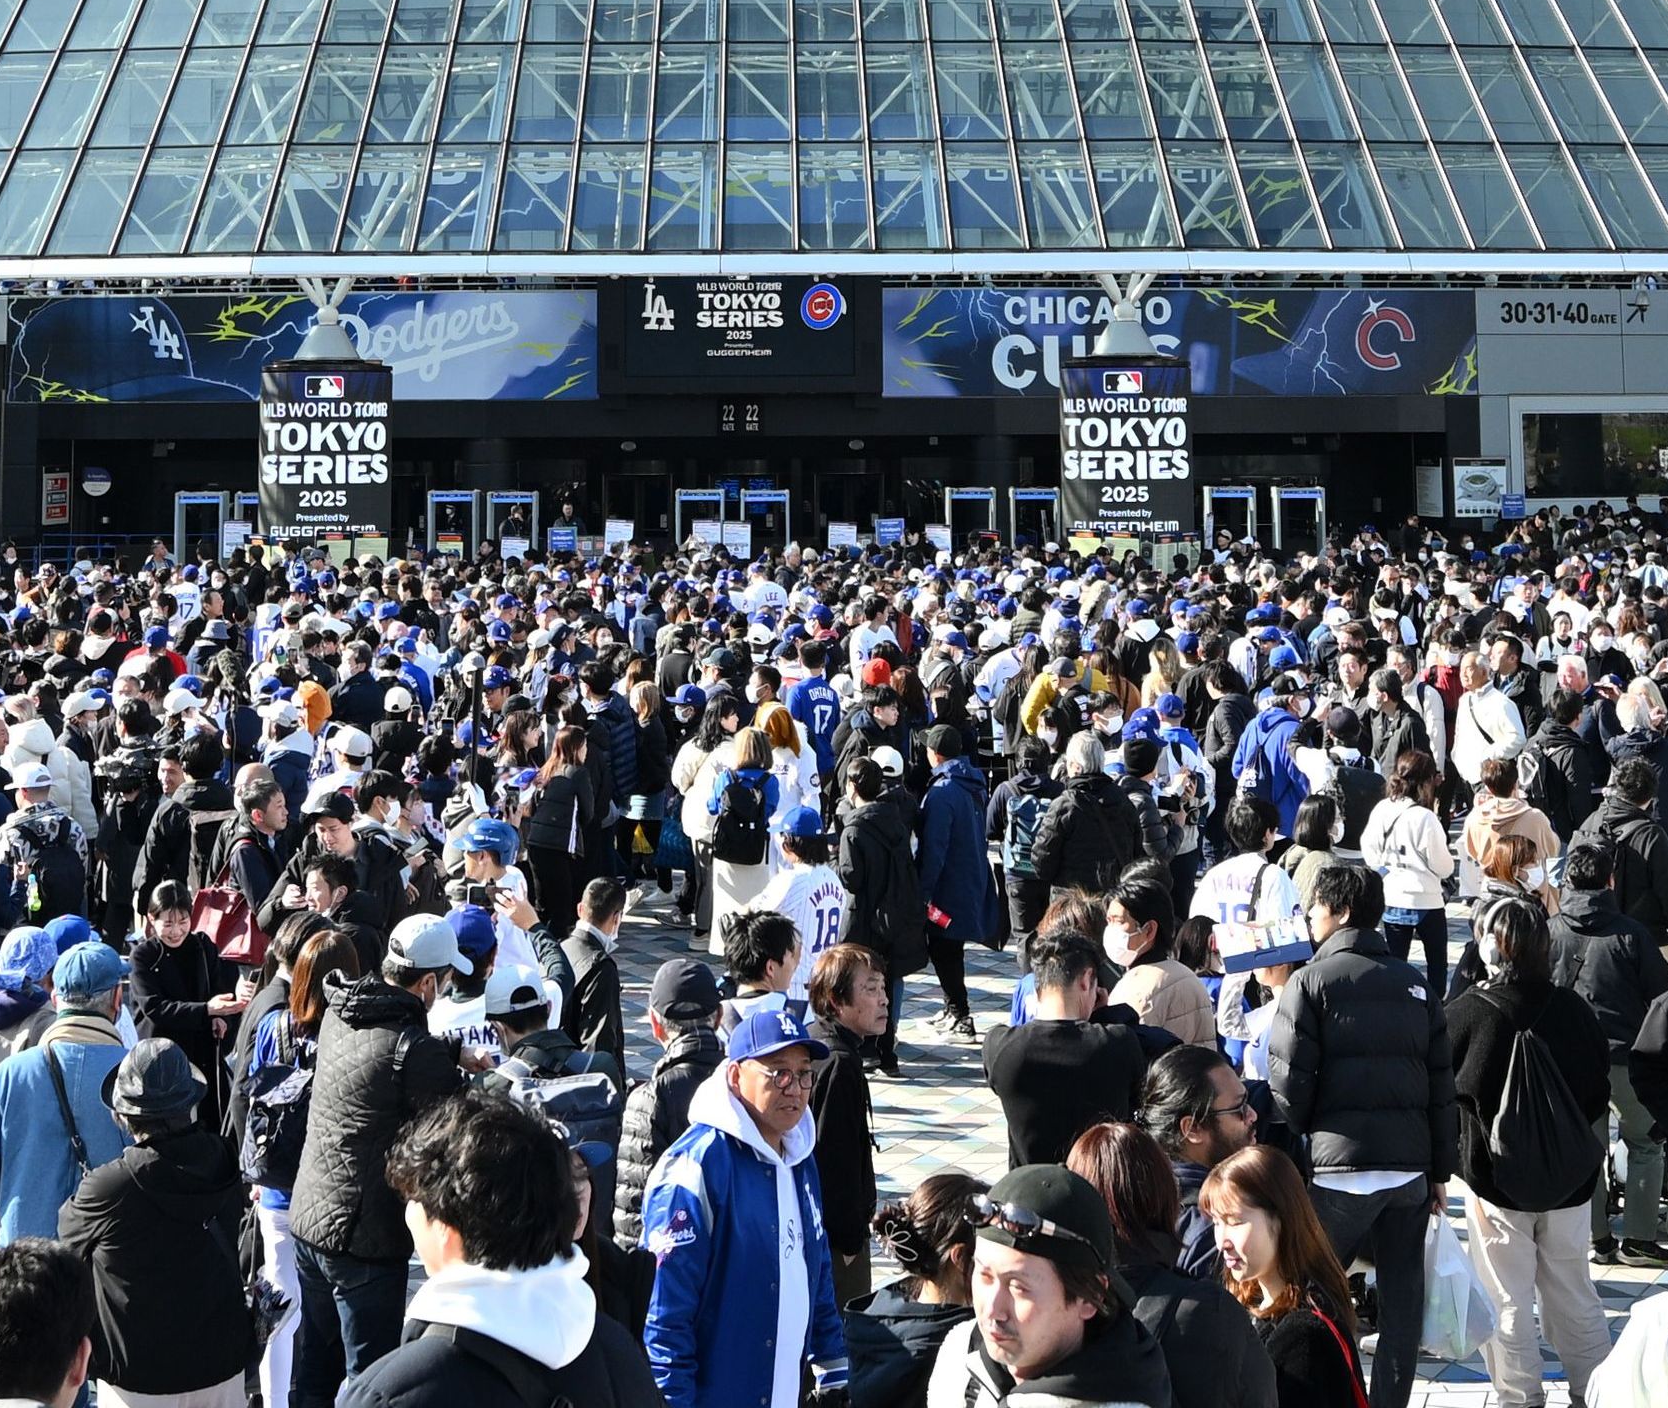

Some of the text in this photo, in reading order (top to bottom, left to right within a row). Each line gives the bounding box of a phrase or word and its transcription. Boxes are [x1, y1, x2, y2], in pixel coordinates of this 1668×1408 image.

[696, 282, 783, 292] MLB WORLD TOUR
[641, 283, 675, 331] LA
[698, 293, 781, 310] TOKYO
[696, 311, 784, 328] SERIES
[1590, 314, 1618, 324] GATE
[726, 330, 752, 340] 2025
[707, 349, 772, 357] GUGGENHEIM
[262, 402, 388, 418] MLB WORLD TOUR
[722, 404, 759, 421] 22 22
[1063, 397, 1187, 413] MLB WORLD TOUR
[263, 421, 387, 452] TOKYO
[1063, 417, 1187, 448] TOKYO
[262, 453, 389, 484] SERIES
[1063, 449, 1190, 480] SERIES
[298, 491, 347, 507] 2025
[1101, 486, 1150, 503] 2025
[295, 513, 350, 523] Presented by
[1098, 509, 1152, 519] Presented by
[765, 592, 779, 602] LEE
[179, 603, 194, 619] 17
[813, 704, 833, 735] 17
[810, 882, 843, 907] IMANAGA
[812, 906, 840, 954] 18
[776, 1013, 800, 1036] LA
